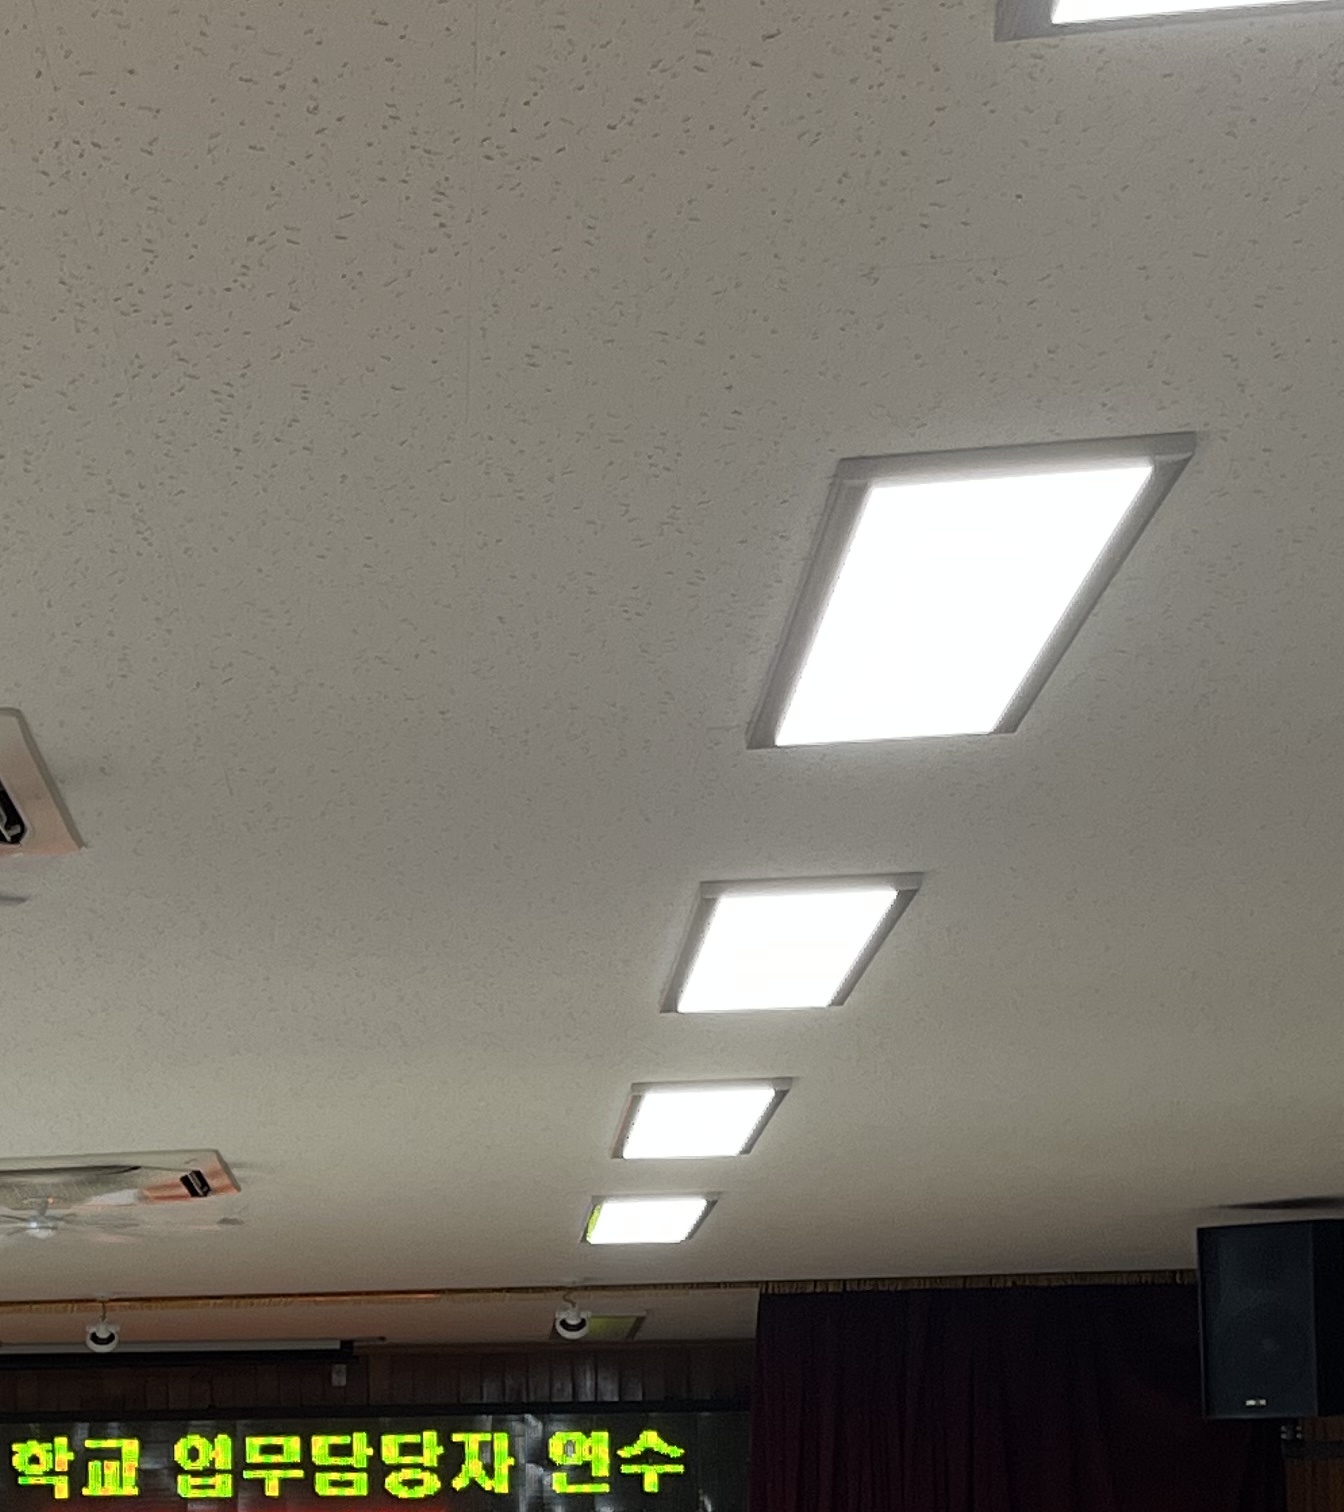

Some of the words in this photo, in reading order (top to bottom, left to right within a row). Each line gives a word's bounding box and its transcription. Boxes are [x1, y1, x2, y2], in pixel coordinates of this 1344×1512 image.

[11, 1436, 139, 1499] 학교
[173, 1430, 515, 1498] 업무담당자
[548, 1429, 684, 1493] 연수
